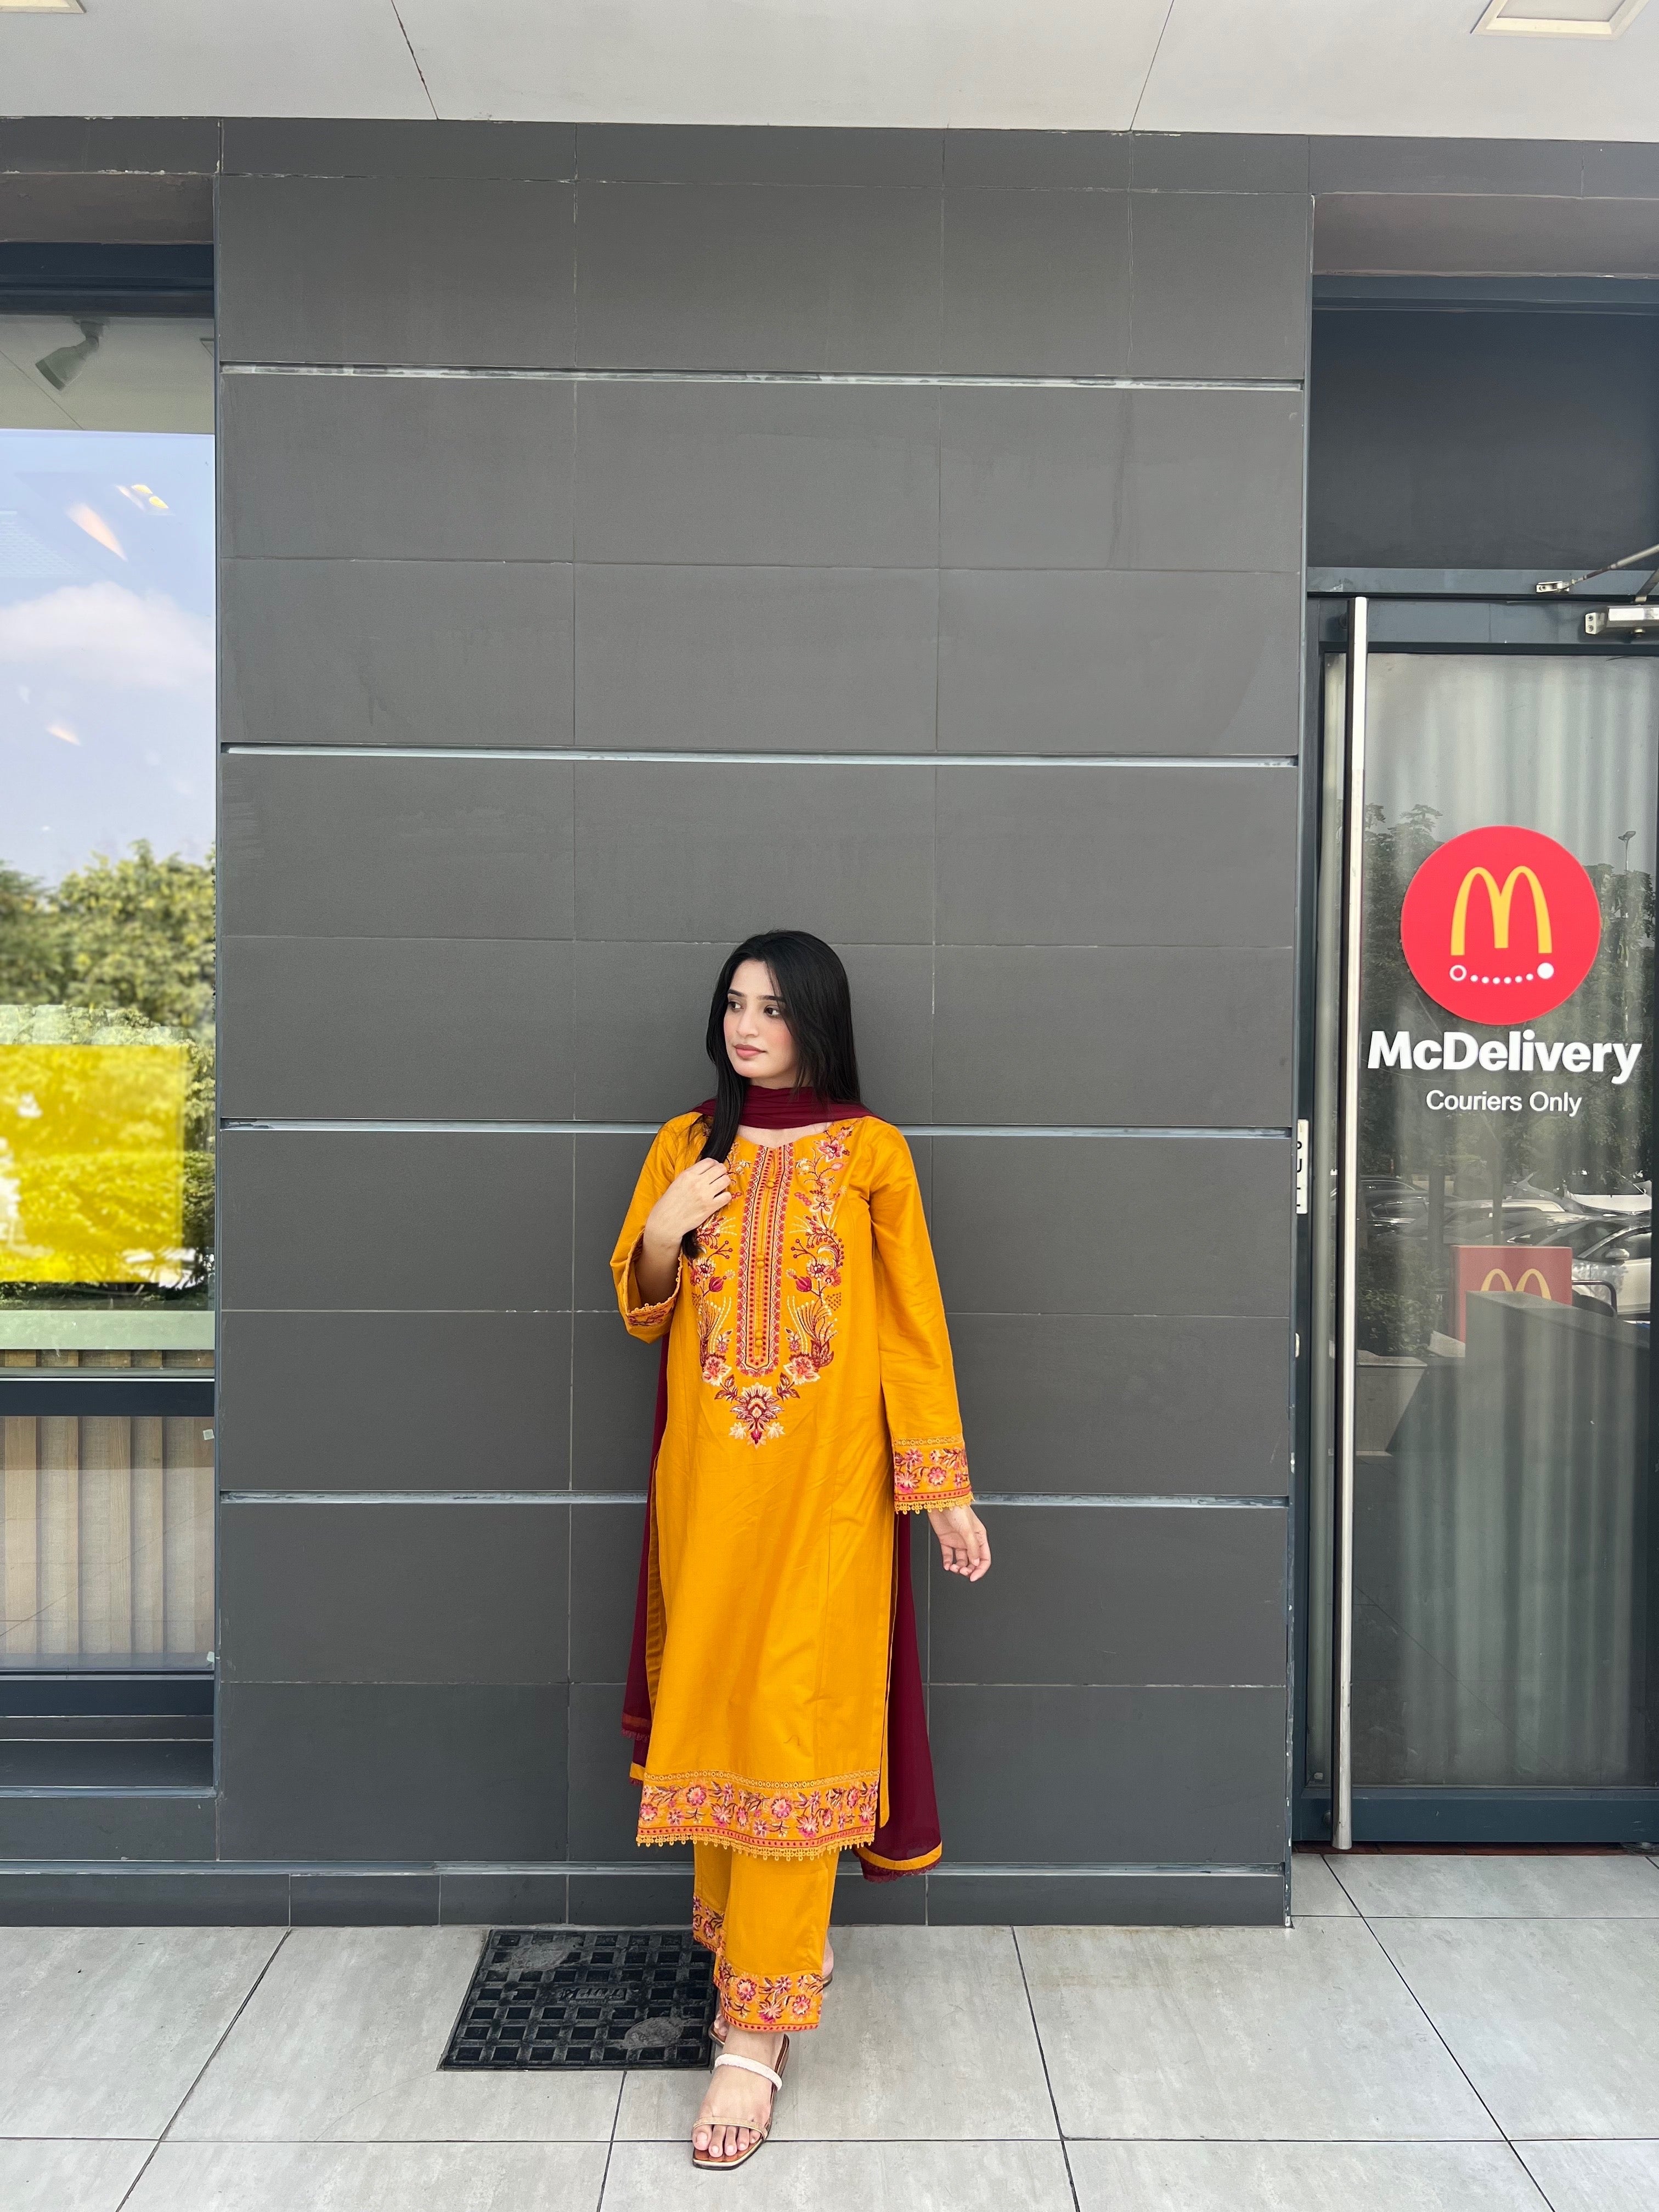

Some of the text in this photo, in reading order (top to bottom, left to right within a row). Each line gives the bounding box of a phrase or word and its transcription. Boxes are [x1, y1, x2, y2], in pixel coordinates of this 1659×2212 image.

[1450, 865, 1553, 956] M
[1367, 1029, 1643, 1085] McDelivery
[1425, 1089, 1583, 1118] Couriers Only
